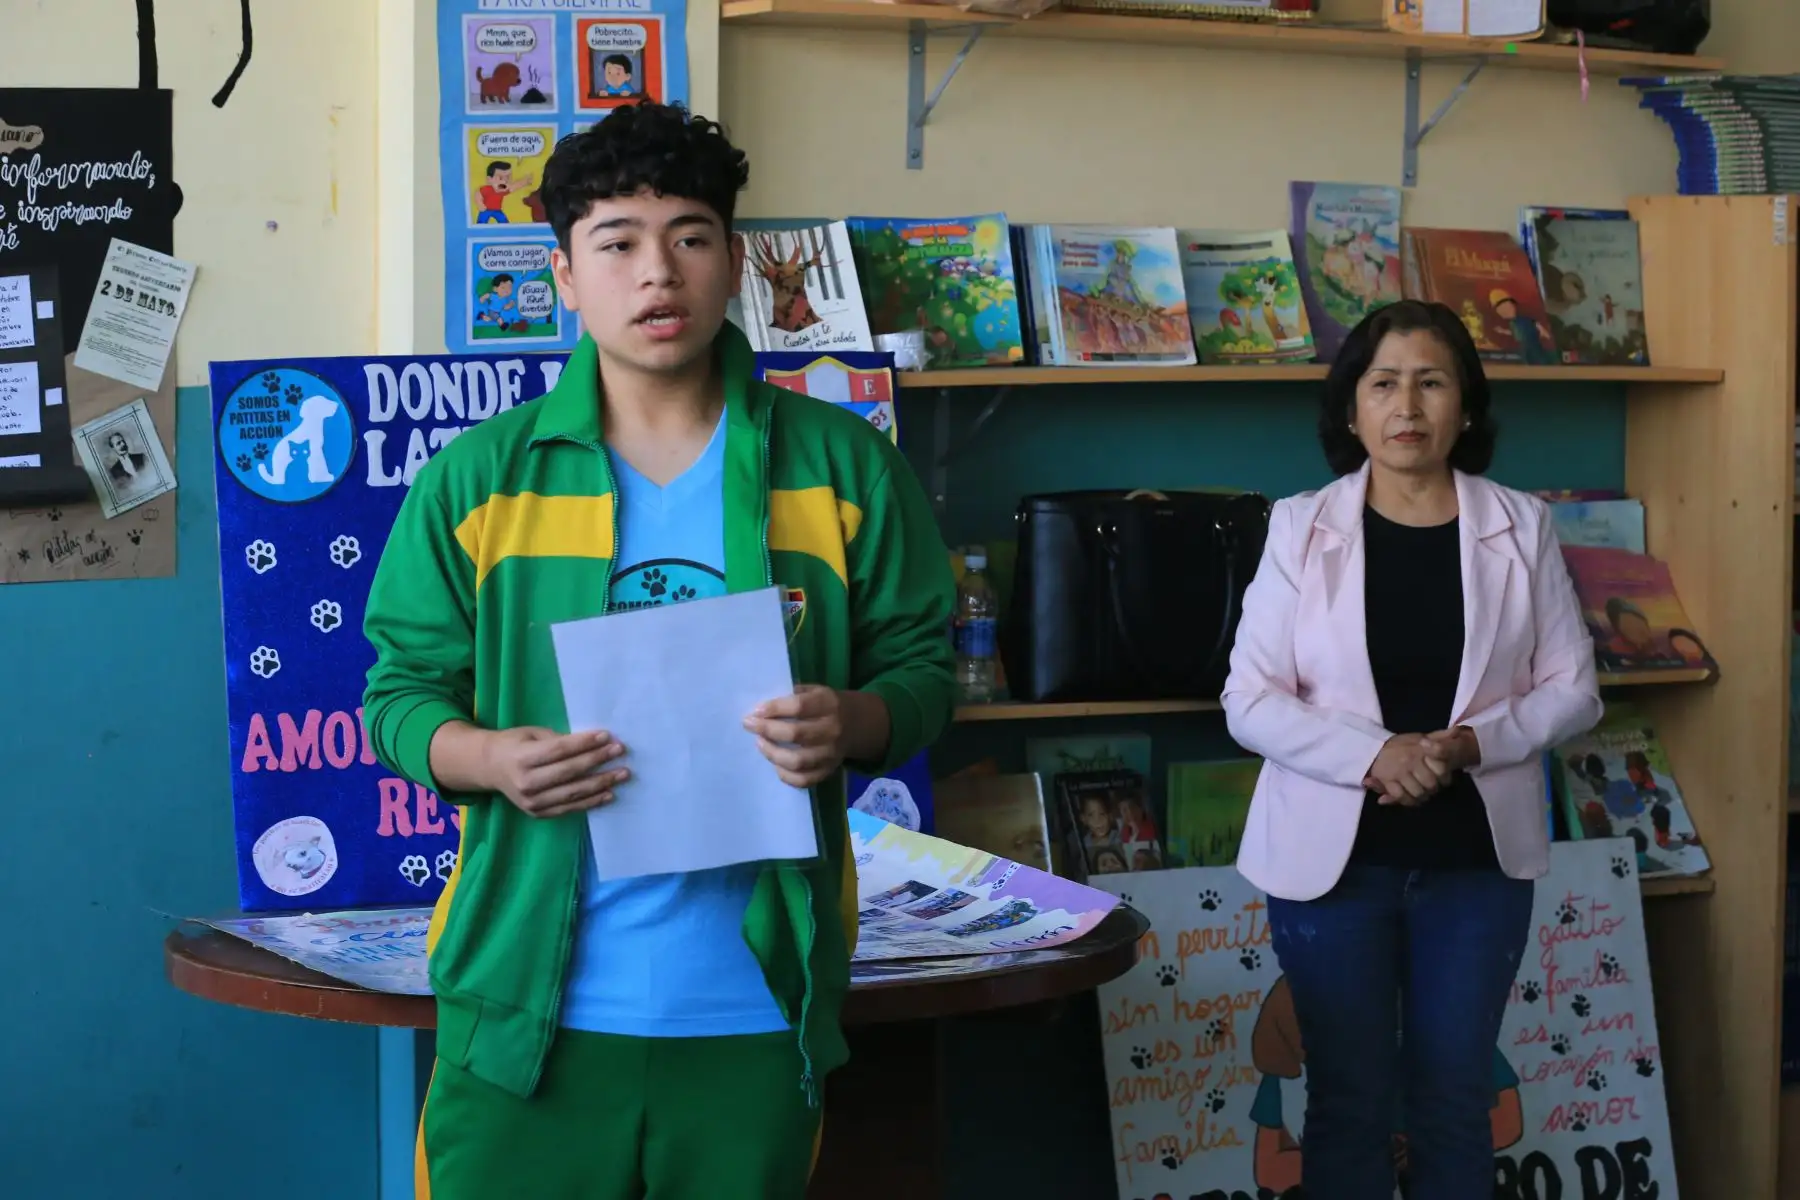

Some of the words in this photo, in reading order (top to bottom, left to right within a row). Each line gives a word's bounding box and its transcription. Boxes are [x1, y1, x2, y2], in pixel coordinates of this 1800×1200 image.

[488, 146, 509, 154] perro
[512, 145, 535, 153] sucio!
[510, 134, 520, 143] de
[484, 248, 513, 259] ¡Vamos
[485, 260, 506, 268] corre
[508, 257, 546, 268] conmigo!
[101, 280, 112, 297] 2
[113, 284, 135, 303] DE
[238, 396, 280, 410] SOMOS
[363, 359, 526, 423] DONDE
[863, 379, 877, 396] E
[229, 410, 275, 425] PATITAS
[277, 409, 291, 423] EN
[363, 426, 470, 487] LAT
[377, 777, 461, 838] RE
[1538, 890, 1627, 969] gatito
[1103, 995, 1161, 1036] sin
[1173, 986, 1263, 1030] hogar
[1513, 1022, 1549, 1046] es
[1580, 1011, 1634, 1037] un
[1151, 1037, 1183, 1064] es
[1192, 1025, 1237, 1061] un
[1110, 1064, 1213, 1118] amigo
[1540, 1095, 1641, 1135] amor
[1117, 1108, 1246, 1185] familia
